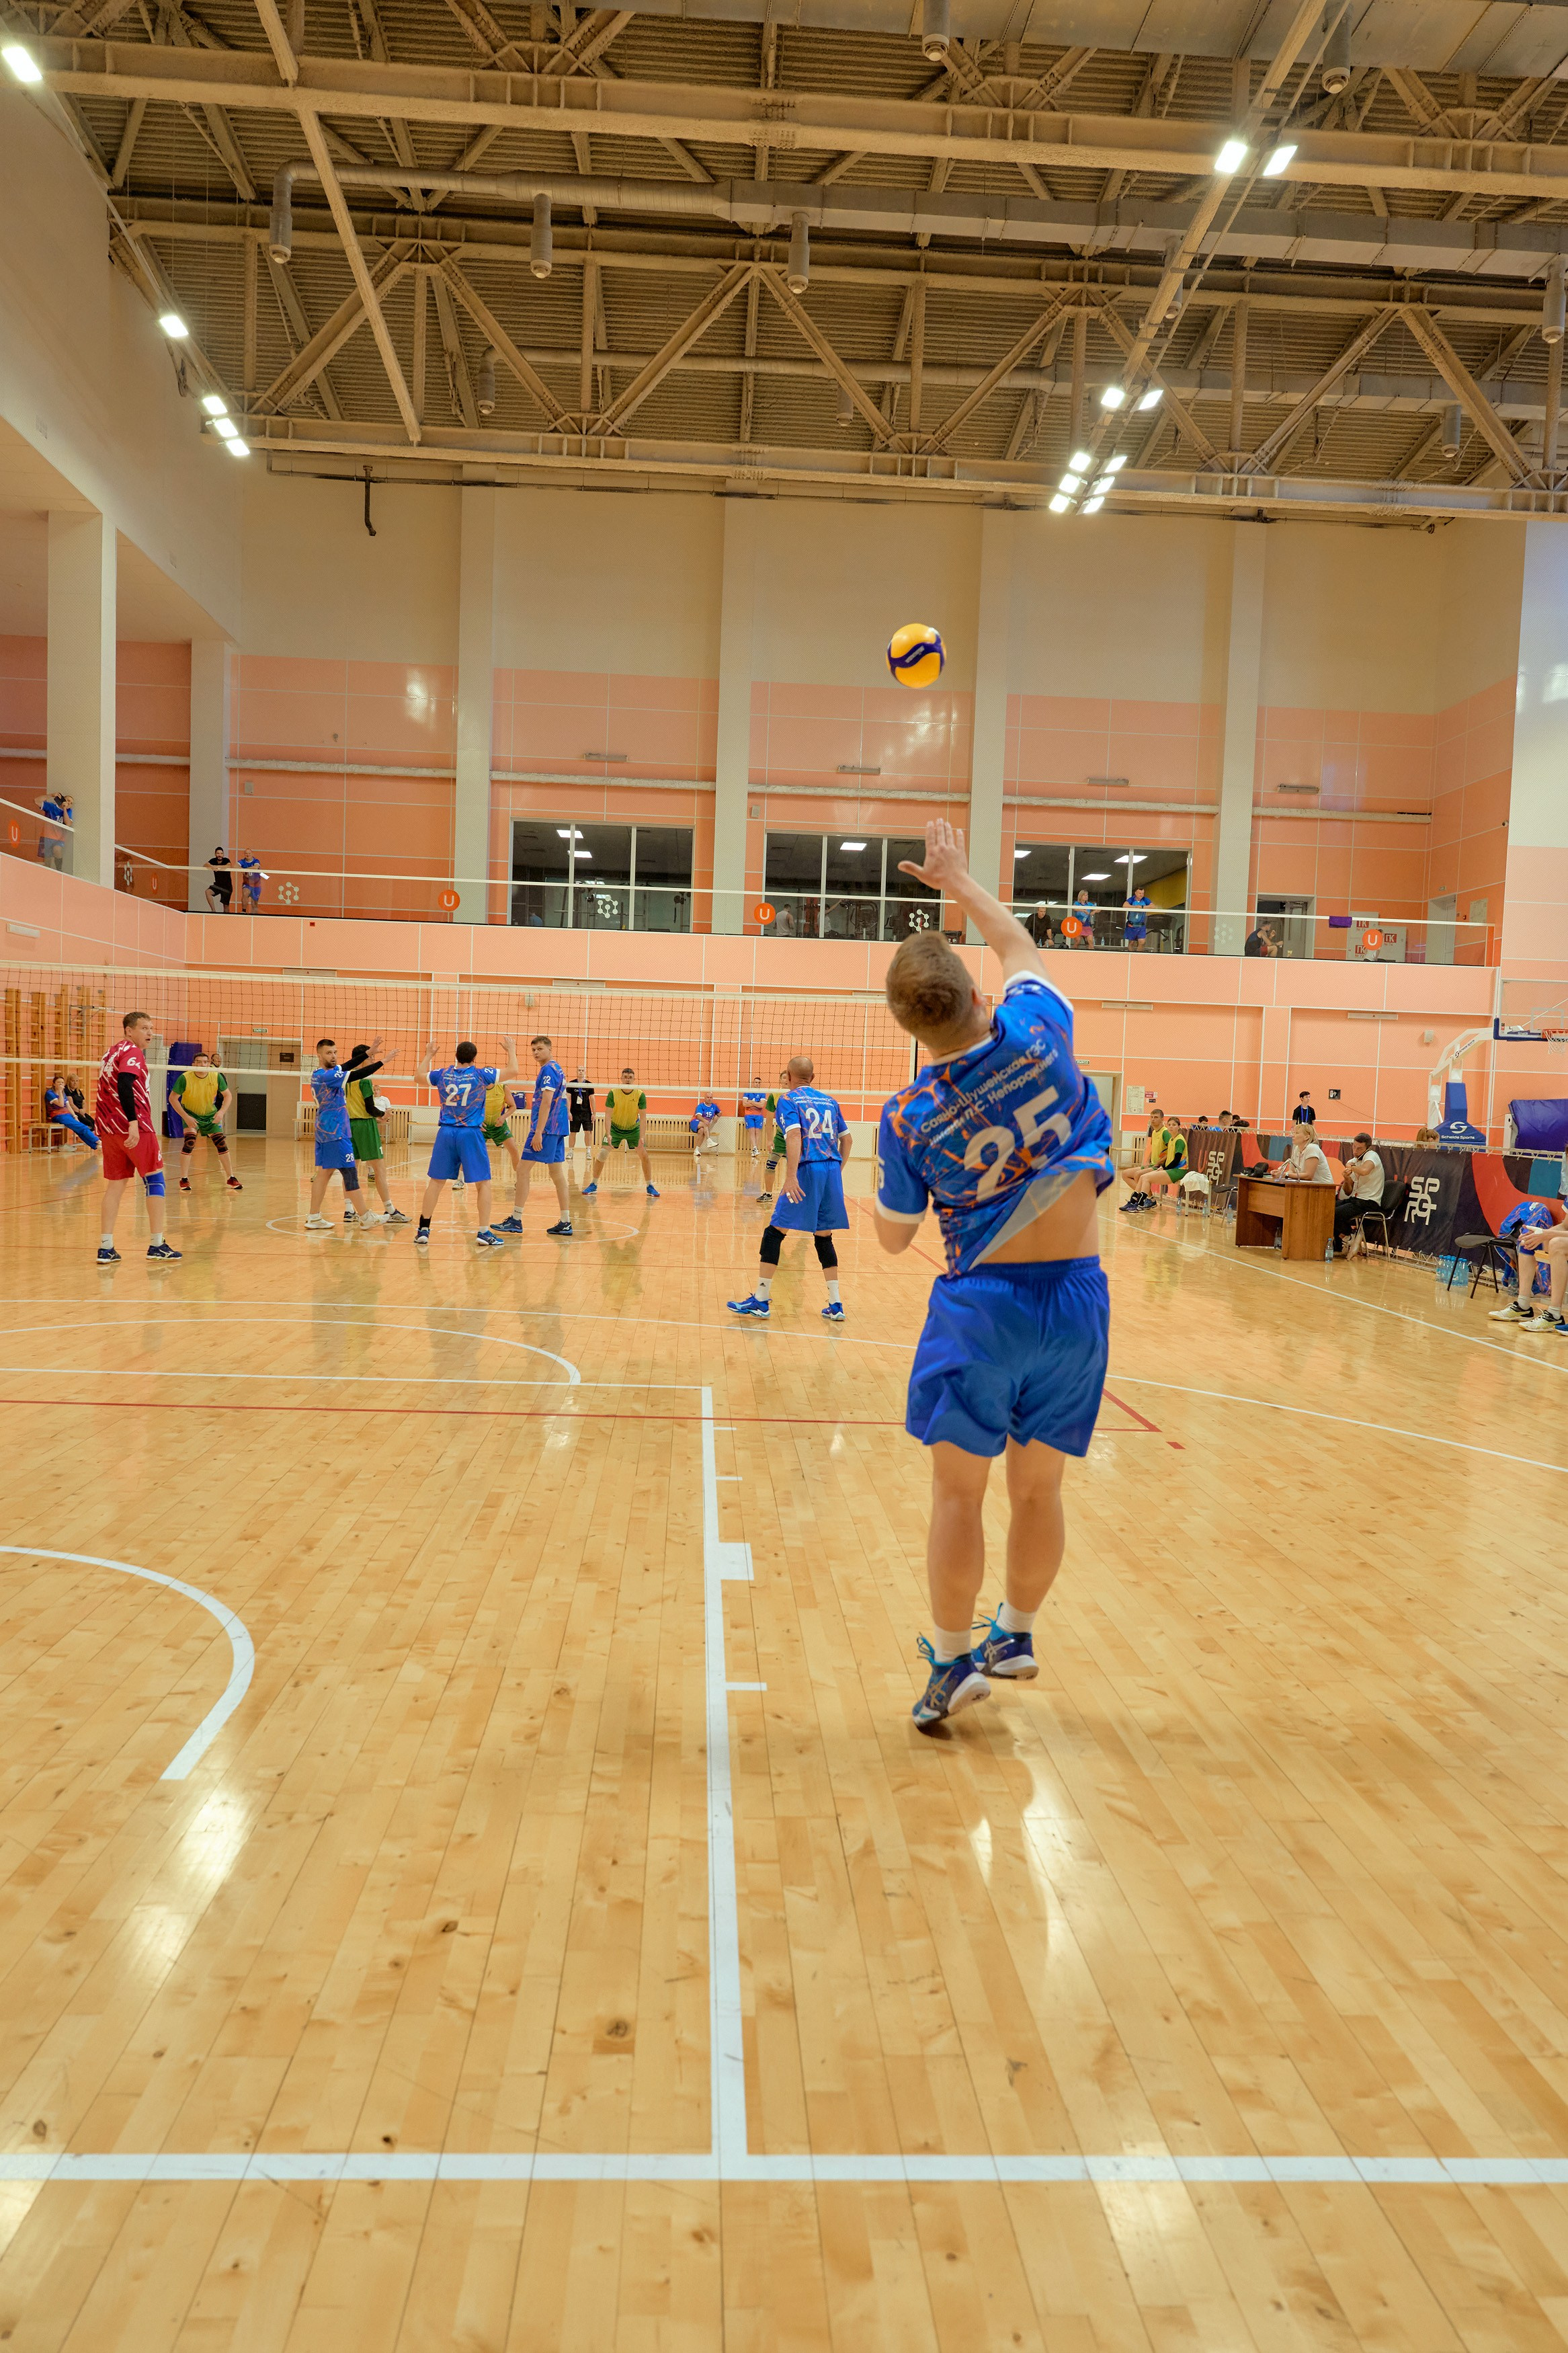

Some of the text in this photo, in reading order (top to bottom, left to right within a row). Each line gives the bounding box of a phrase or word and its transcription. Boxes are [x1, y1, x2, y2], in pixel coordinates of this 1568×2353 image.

[11, 826, 18, 842] U
[152, 877, 157, 890] U
[444, 895, 454, 907] U
[759, 908, 770, 920] U
[1067, 922, 1077, 934] U
[1368, 934, 1378, 946] U
[1385, 934, 1395, 943] ПК
[542, 1076, 551, 1084] 22
[921, 1038, 1046, 1133] Саяно-Шушенская ГЭС
[446, 1084, 472, 1107] 27
[805, 1107, 834, 1140] 24
[963, 1085, 1073, 1202] 25
[345, 1153, 354, 1162] 28
